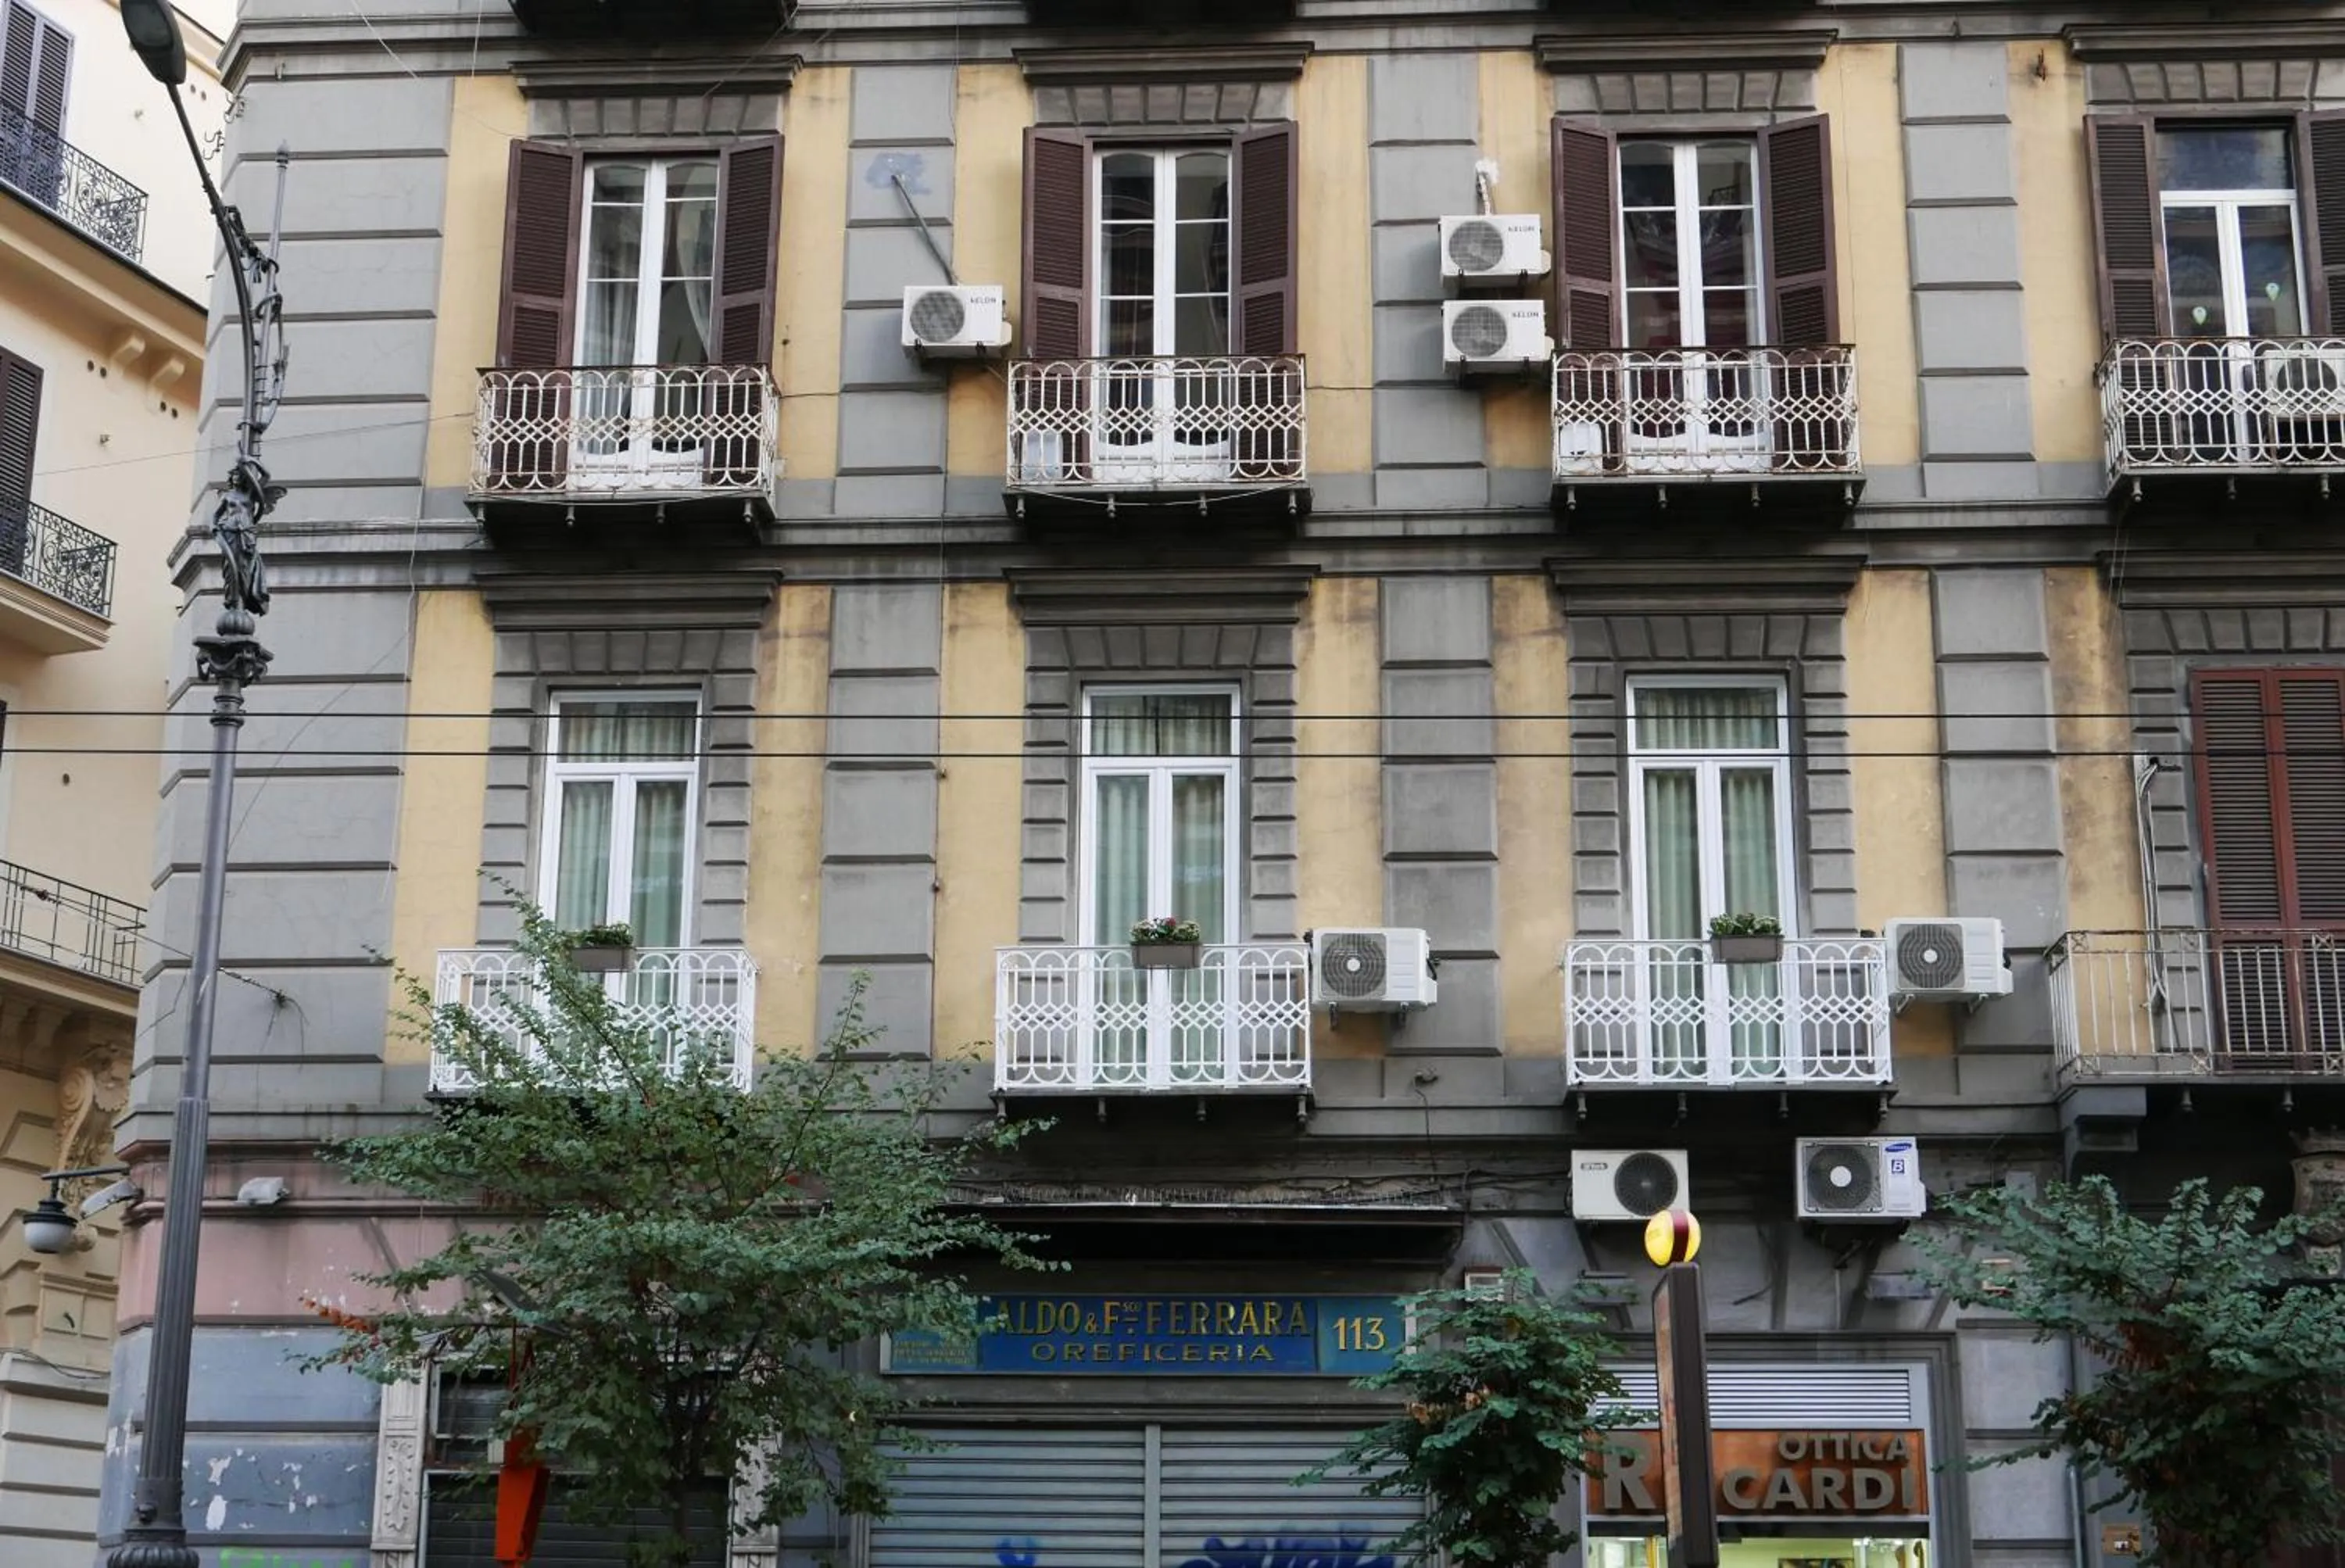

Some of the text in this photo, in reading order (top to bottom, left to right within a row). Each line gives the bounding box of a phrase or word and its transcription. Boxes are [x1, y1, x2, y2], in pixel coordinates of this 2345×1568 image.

[1146, 1300, 1310, 1336] FERRARA
[1333, 1316, 1387, 1351] 113
[1032, 1342, 1276, 1362] OREFICERIA
[1778, 1430, 1910, 1461] OTTICA
